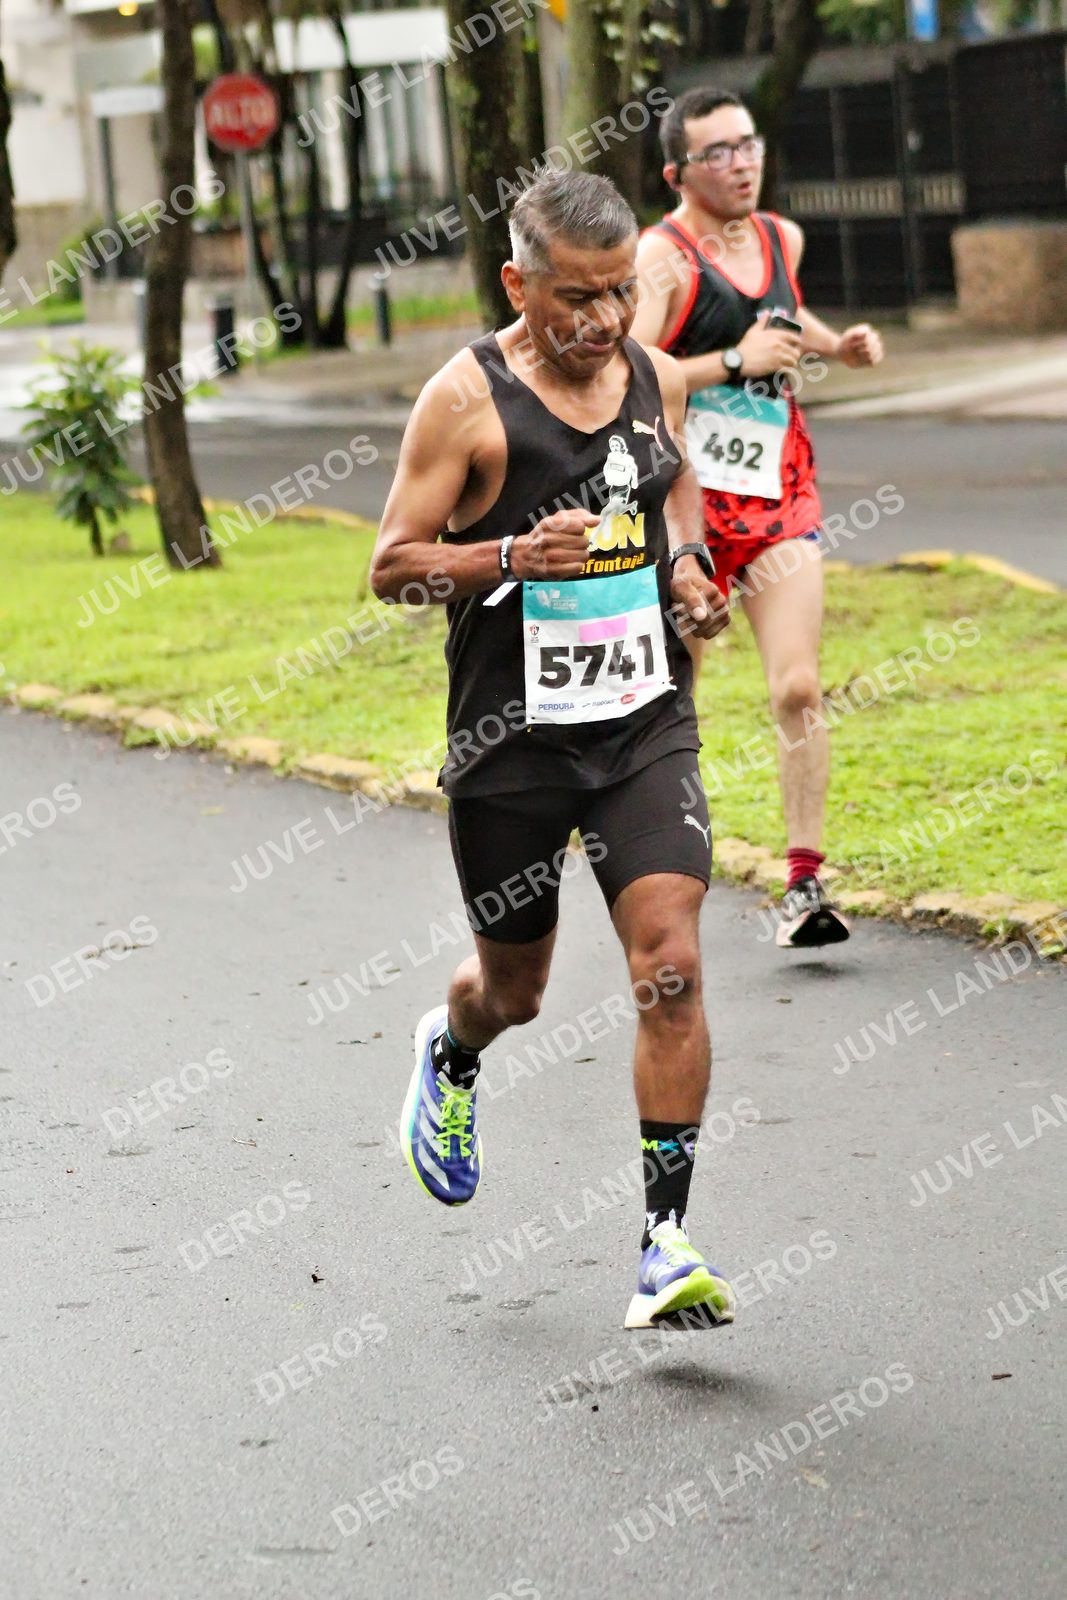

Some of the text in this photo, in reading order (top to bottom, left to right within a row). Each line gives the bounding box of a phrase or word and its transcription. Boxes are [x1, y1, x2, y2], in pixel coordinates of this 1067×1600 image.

[208, 95, 276, 129] ALTO
[702, 432, 763, 471] 492
[585, 513, 646, 551] UN
[537, 633, 654, 690] 5741
[537, 702, 575, 711] PERDURA
